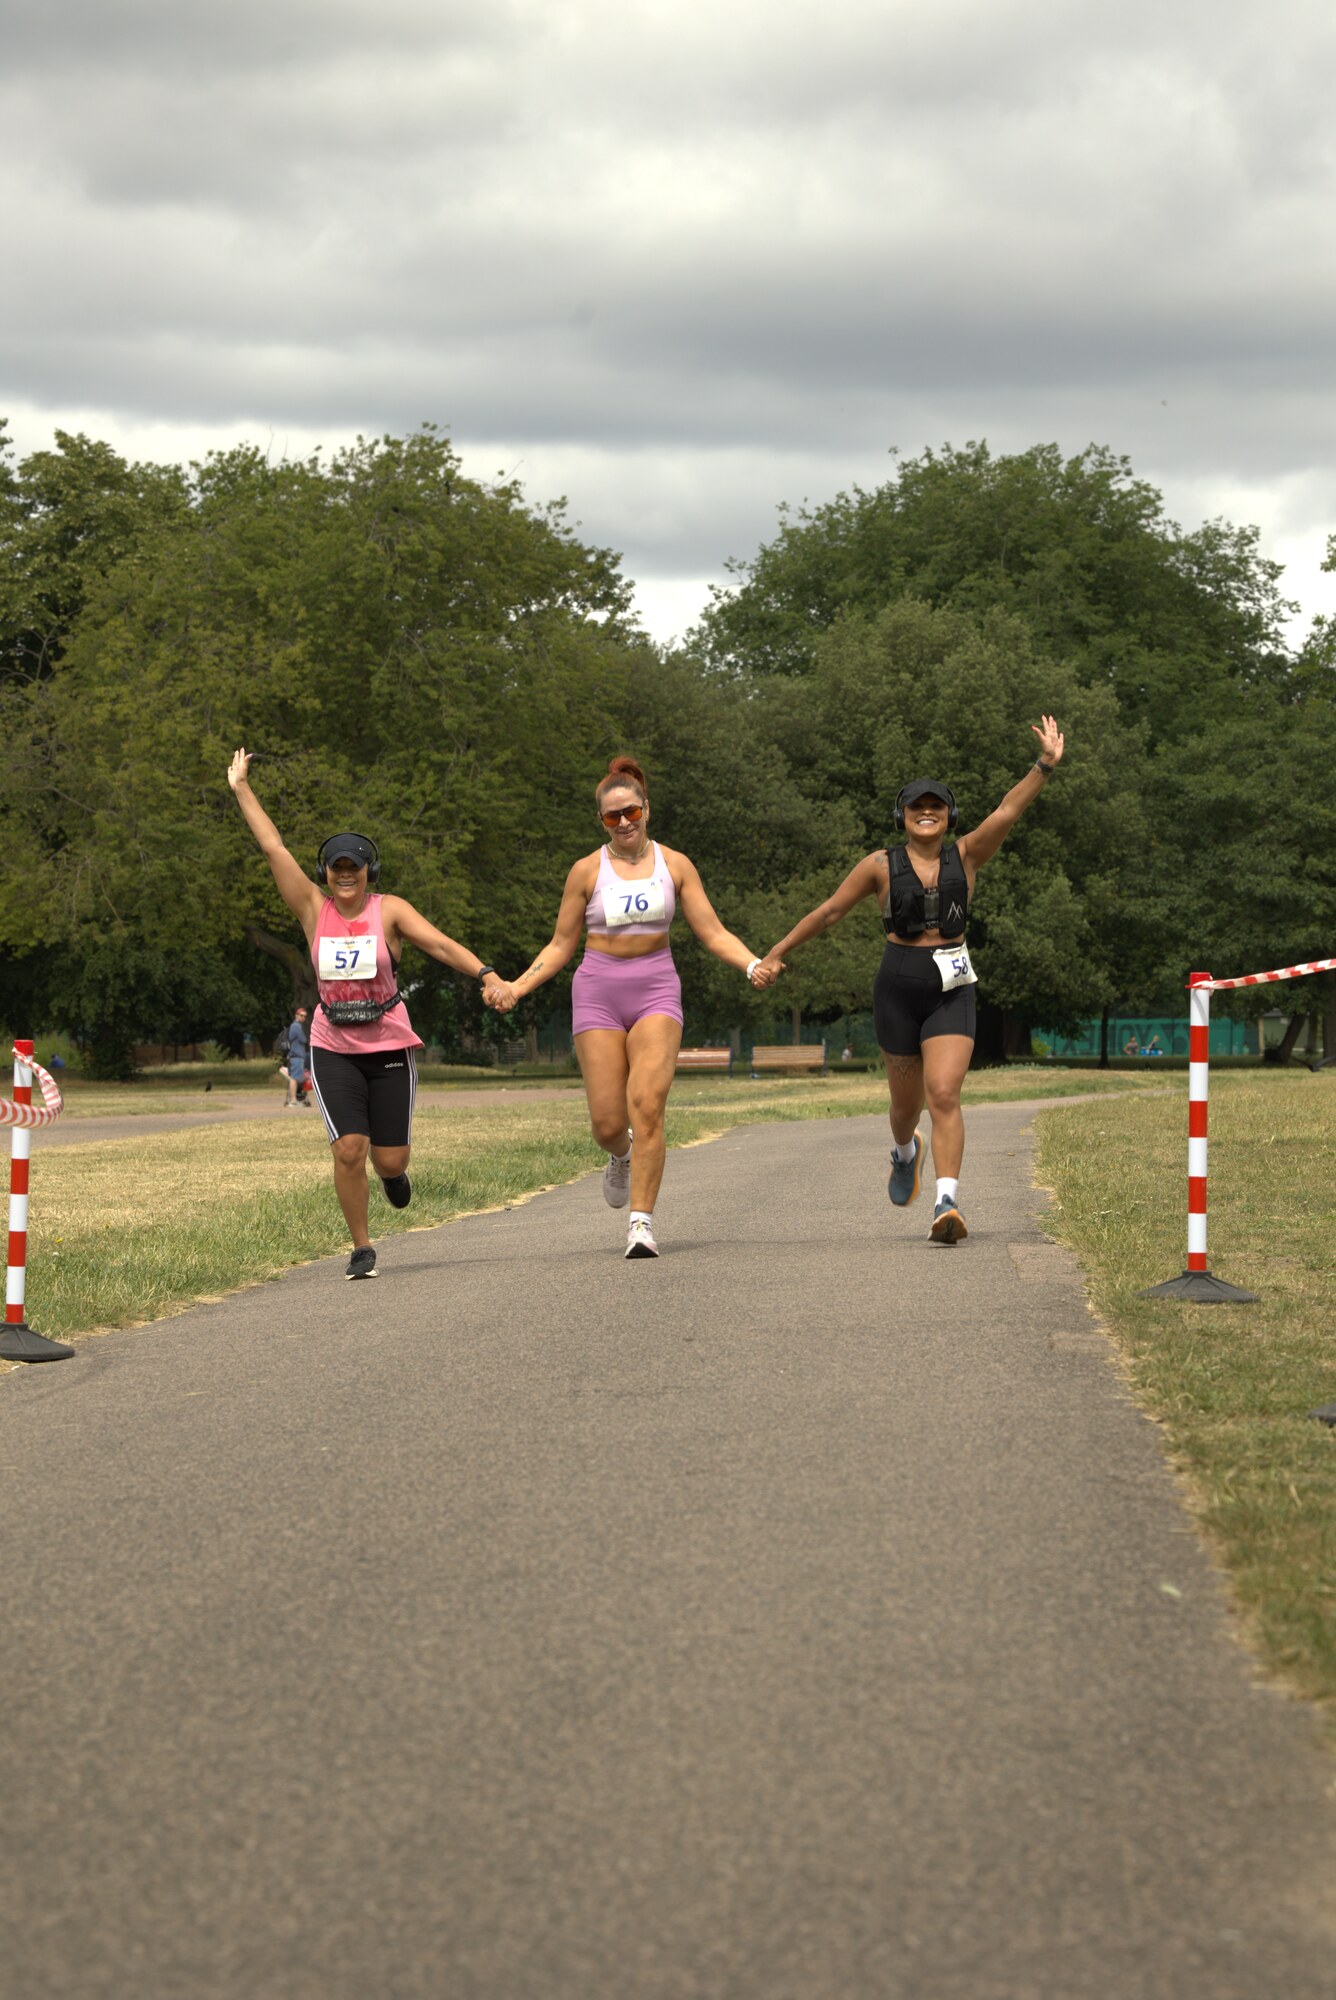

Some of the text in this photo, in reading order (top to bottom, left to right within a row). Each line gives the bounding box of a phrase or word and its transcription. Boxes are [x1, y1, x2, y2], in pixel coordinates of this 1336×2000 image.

[619, 892, 649, 914] 76
[335, 950, 360, 969] 57
[951, 956, 969, 978] 58
